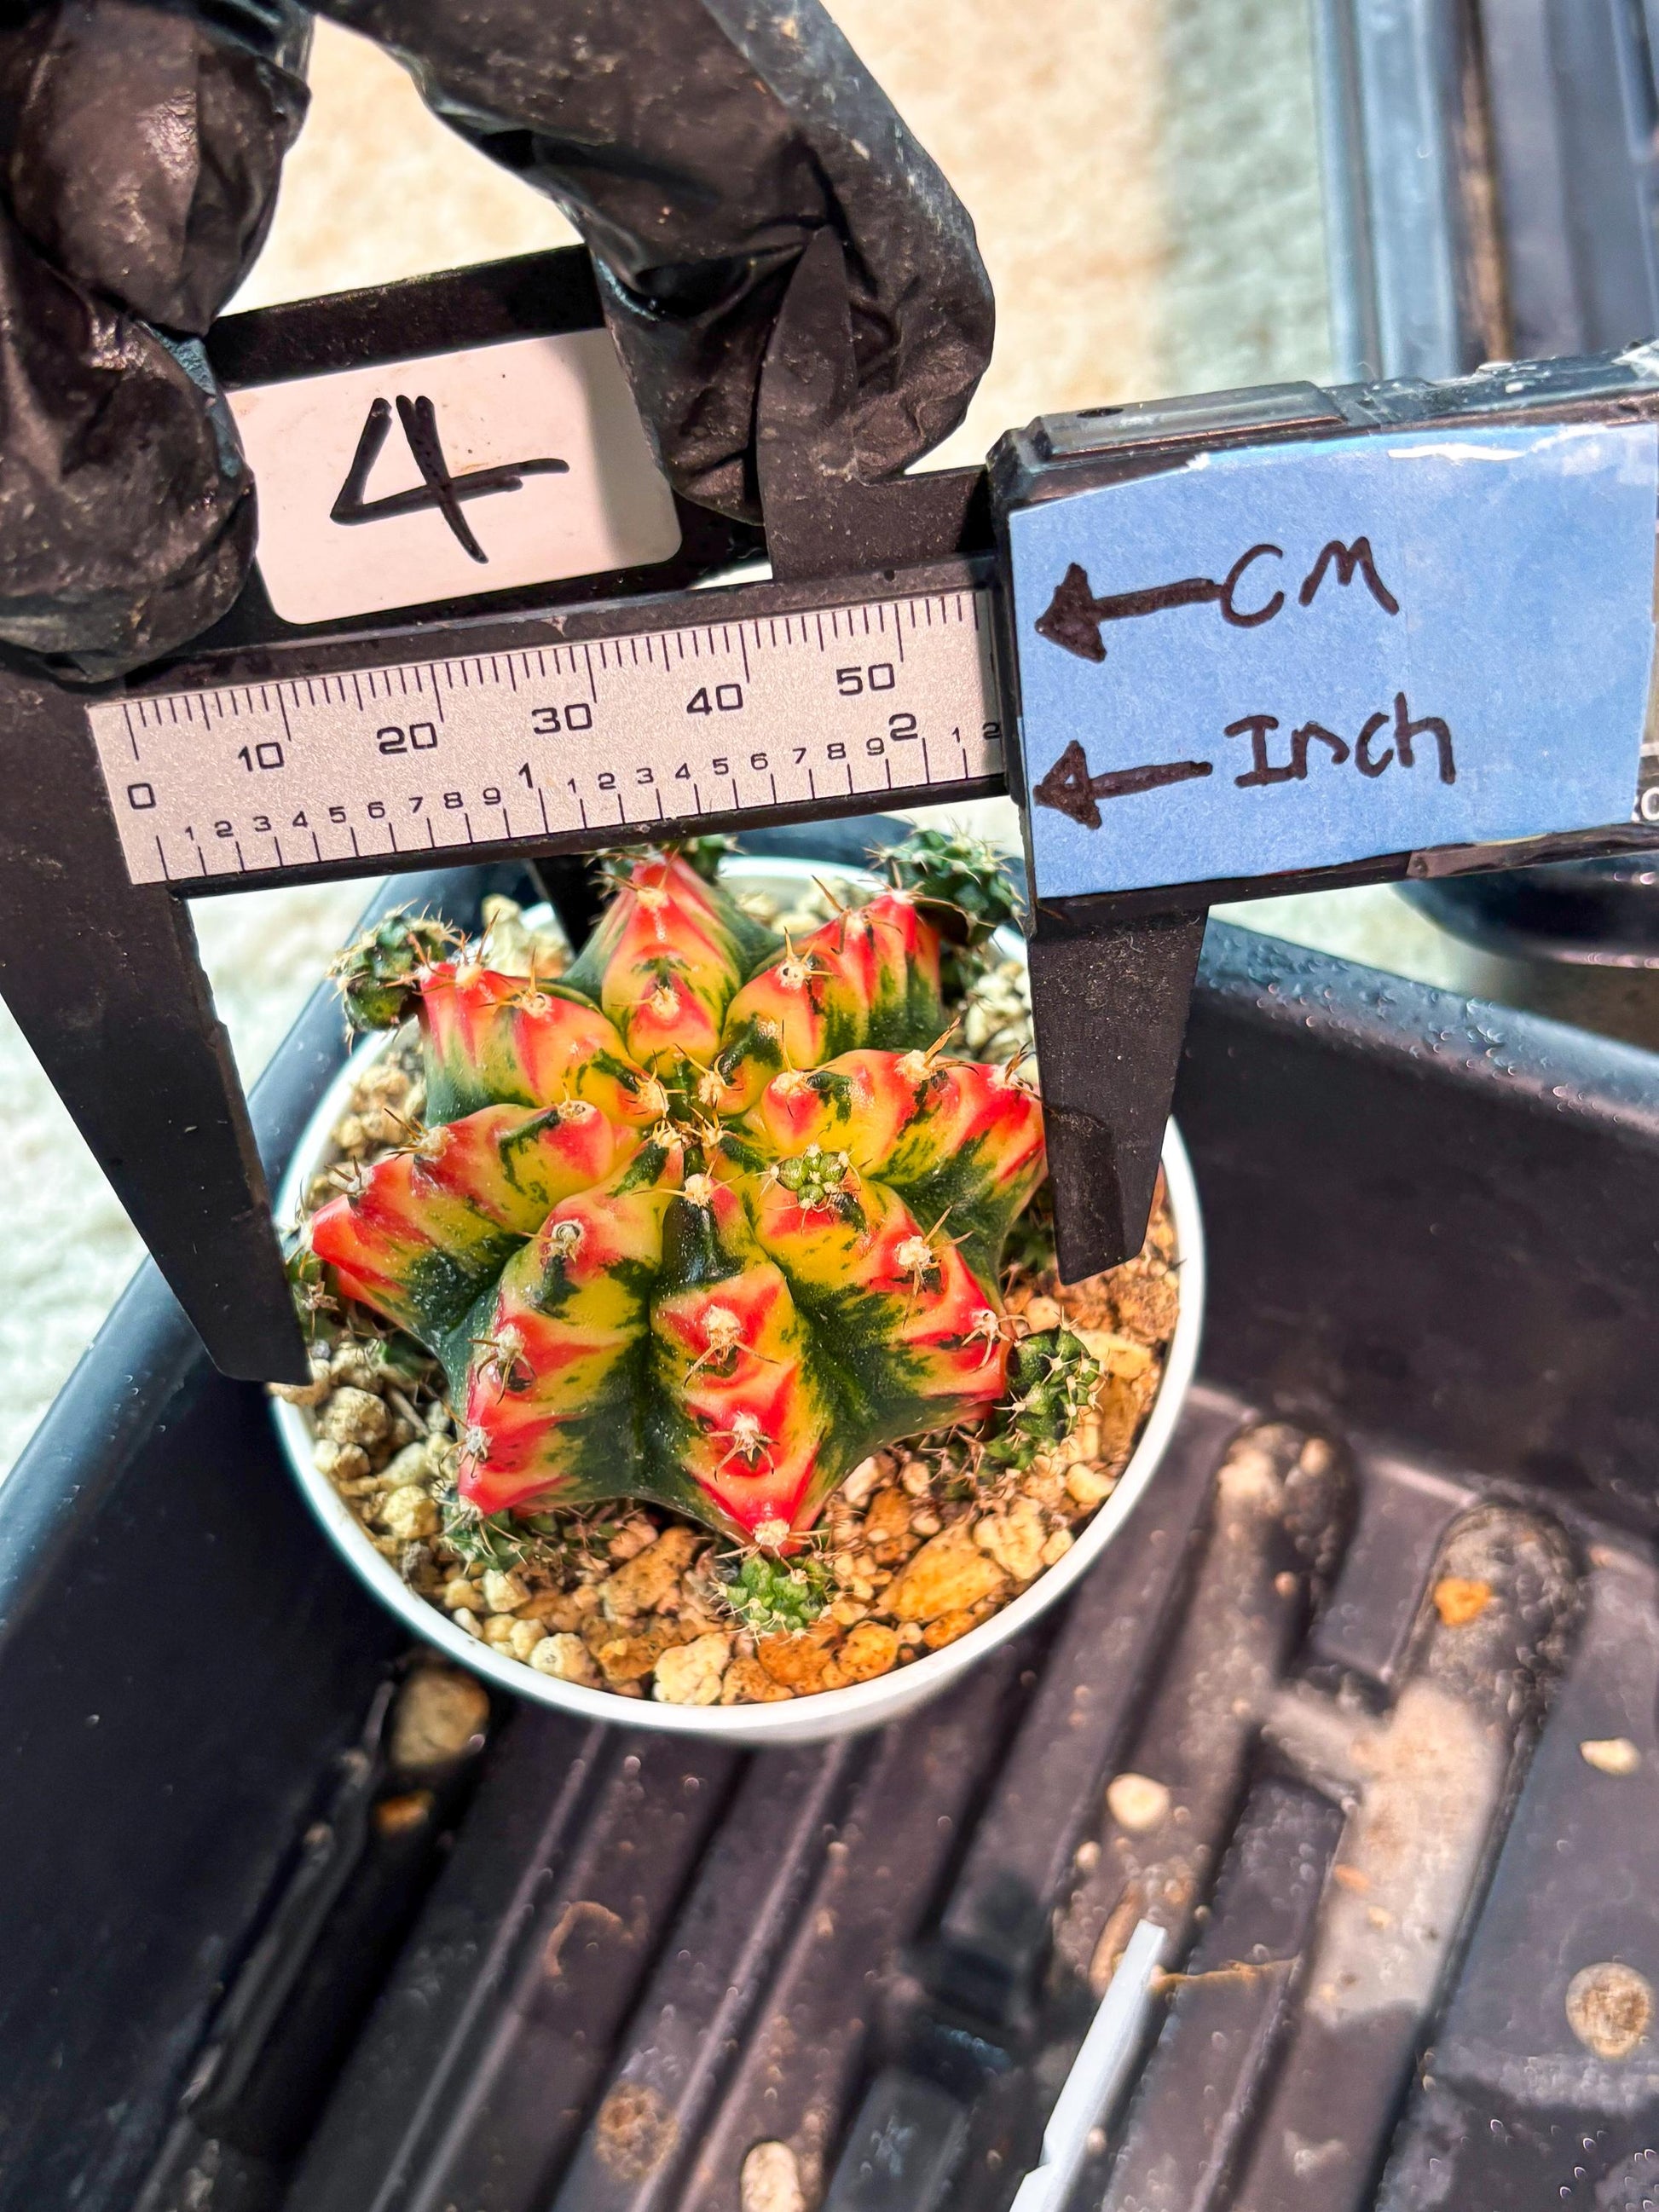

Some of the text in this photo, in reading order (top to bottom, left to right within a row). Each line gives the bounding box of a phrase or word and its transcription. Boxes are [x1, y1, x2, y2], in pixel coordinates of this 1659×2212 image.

[330, 395, 570, 564] 4
[1221, 537, 1400, 628] CM
[128, 663, 894, 809] 0 10 20 30 40 50
[186, 713, 1002, 841] 1 2 3 4 5 6 7 8 9 1 1 2 3 4 5 6 7 8 9 2 1 2
[1224, 691, 1456, 786] Inch
